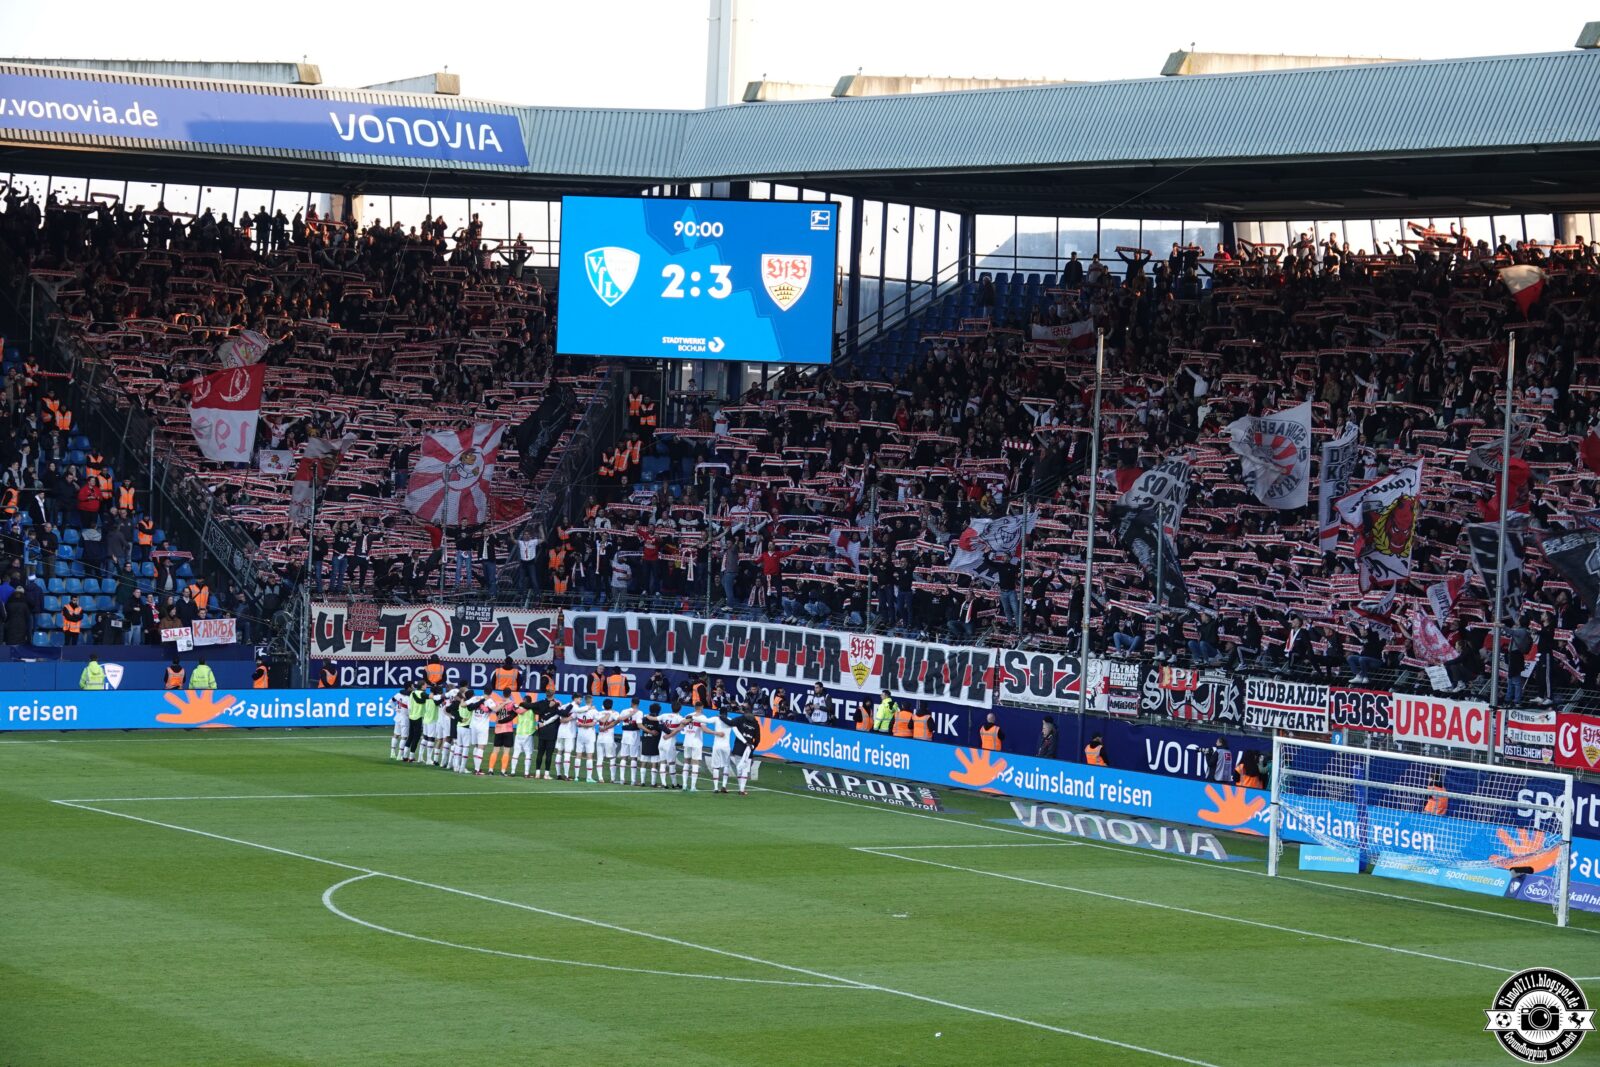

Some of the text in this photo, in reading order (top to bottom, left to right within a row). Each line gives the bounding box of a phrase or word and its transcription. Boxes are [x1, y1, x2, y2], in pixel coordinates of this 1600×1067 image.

[329, 112, 504, 153] VONOVIA
[673, 221, 724, 238] 90:00
[662, 337, 706, 345] STADTWERKE
[678, 344, 706, 352] BOCHUM
[163, 628, 190, 638] SILAS
[573, 616, 989, 702] CANNSTATTER KURVE
[1110, 662, 1139, 673] ULTRAS
[340, 660, 460, 687] parkase
[1110, 672, 1139, 681] BEDEUTET
[1247, 680, 1328, 707] SÜDBANDE
[8, 700, 78, 722] reisen
[356, 696, 396, 718] reis
[1245, 707, 1326, 732] STUTTGART
[1395, 699, 1502, 747] URBACH
[1334, 733, 1341, 745] 9
[1509, 730, 1541, 742] Inferno
[865, 747, 910, 770] reisen
[1504, 745, 1542, 760] OSTELSHEIM
[801, 768, 915, 802] KIPOR
[1100, 779, 1152, 808] reisen
[807, 784, 938, 812] Generatoren vom Profi
[1374, 821, 1435, 852] reisen
[1304, 853, 1355, 864] sportwetten.de
[1444, 868, 1505, 888] sportwetten.de
[1525, 883, 1548, 897] Seco
